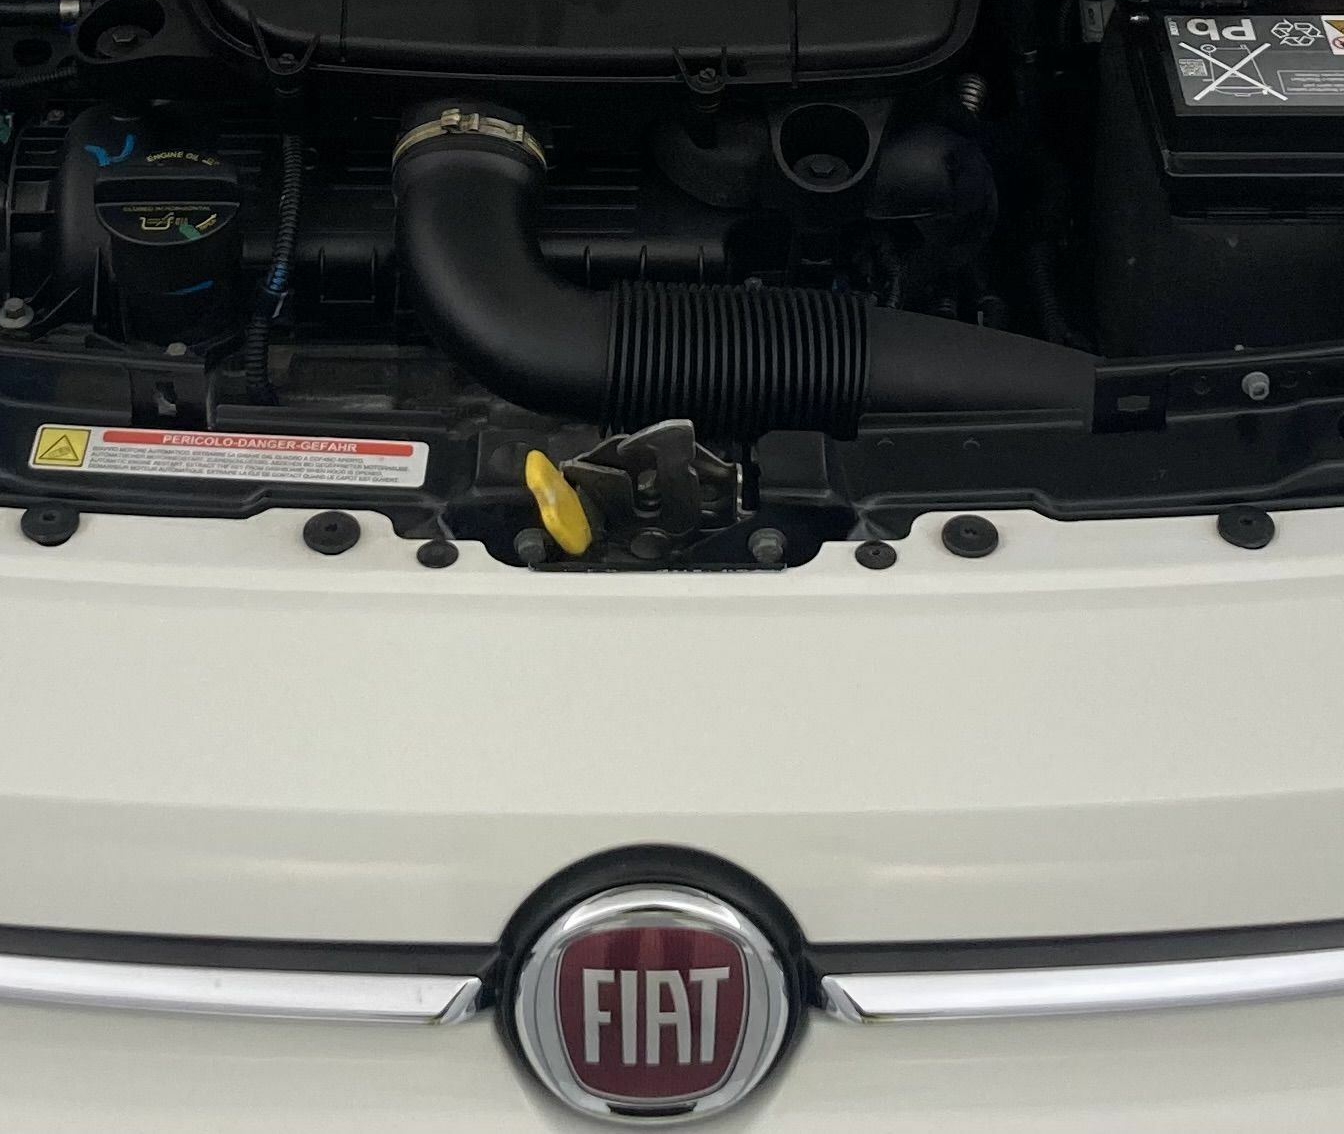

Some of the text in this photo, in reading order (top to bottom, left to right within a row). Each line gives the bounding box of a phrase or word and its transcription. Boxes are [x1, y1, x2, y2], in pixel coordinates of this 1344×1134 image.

[1186, 18, 1257, 41] Pb
[146, 150, 184, 163] ENGINE
[582, 966, 731, 1066] FIAT
